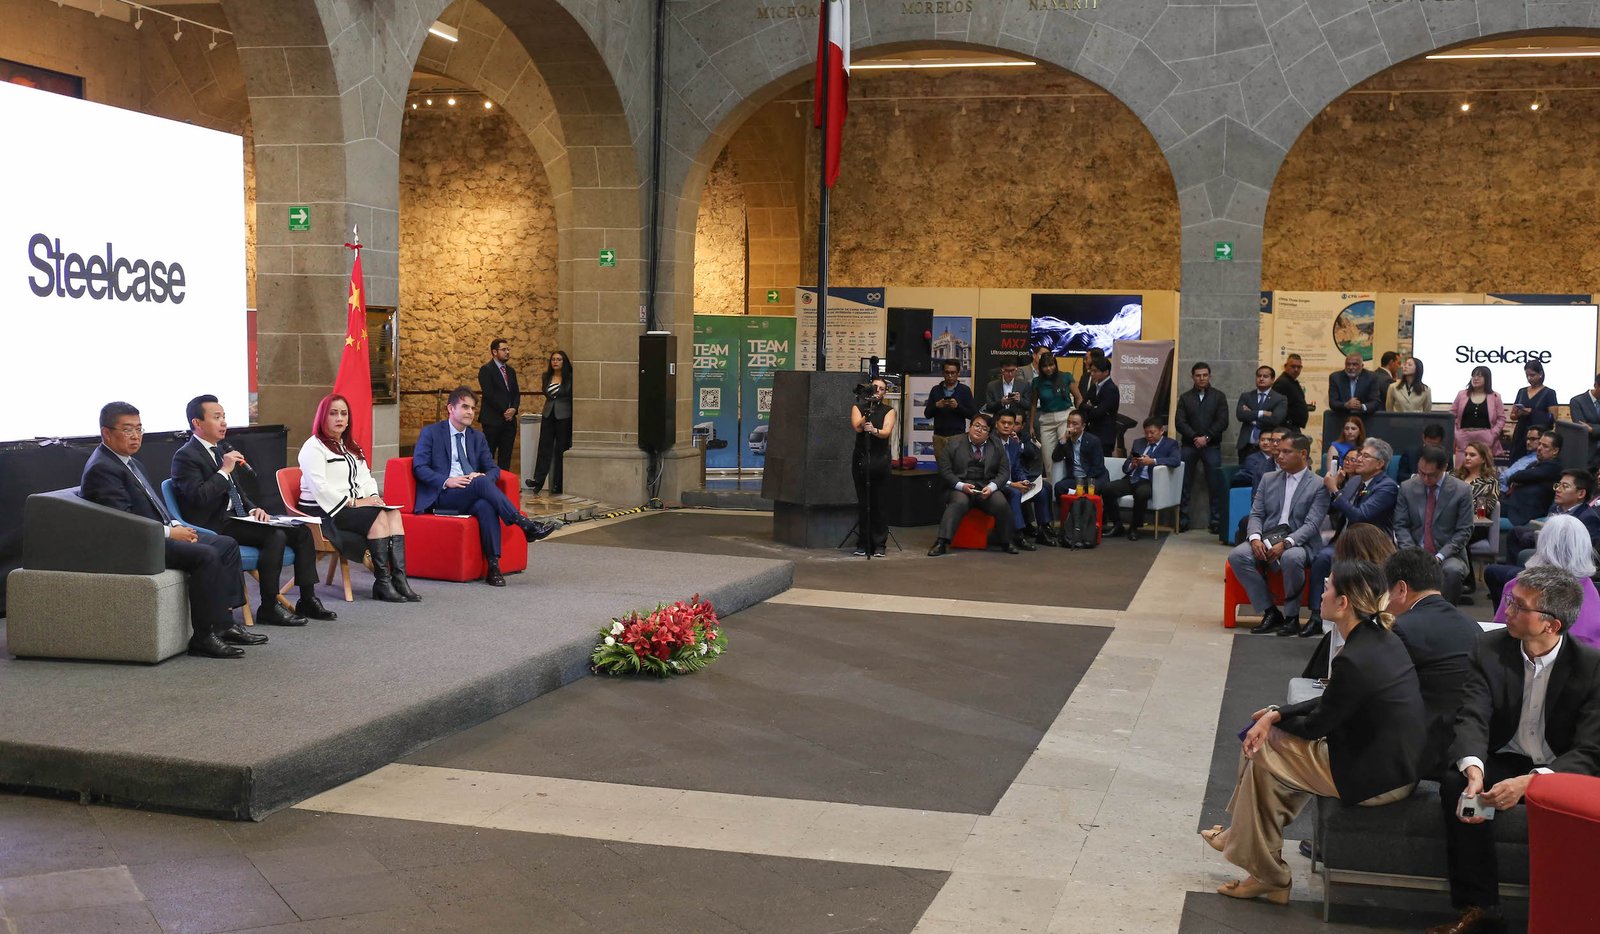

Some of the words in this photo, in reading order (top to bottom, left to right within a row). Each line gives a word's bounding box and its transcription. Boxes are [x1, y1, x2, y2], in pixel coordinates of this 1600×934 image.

[756, 4, 820, 19] MICHOA
[901, 0, 974, 15] MORELOS
[28, 232, 186, 305] Steelcase
[693, 344, 729, 356] TEAM
[747, 340, 789, 353] TEAM
[1001, 338, 1026, 348] MX7
[1120, 354, 1159, 365] Steelcase
[1455, 345, 1552, 364] Steelcase
